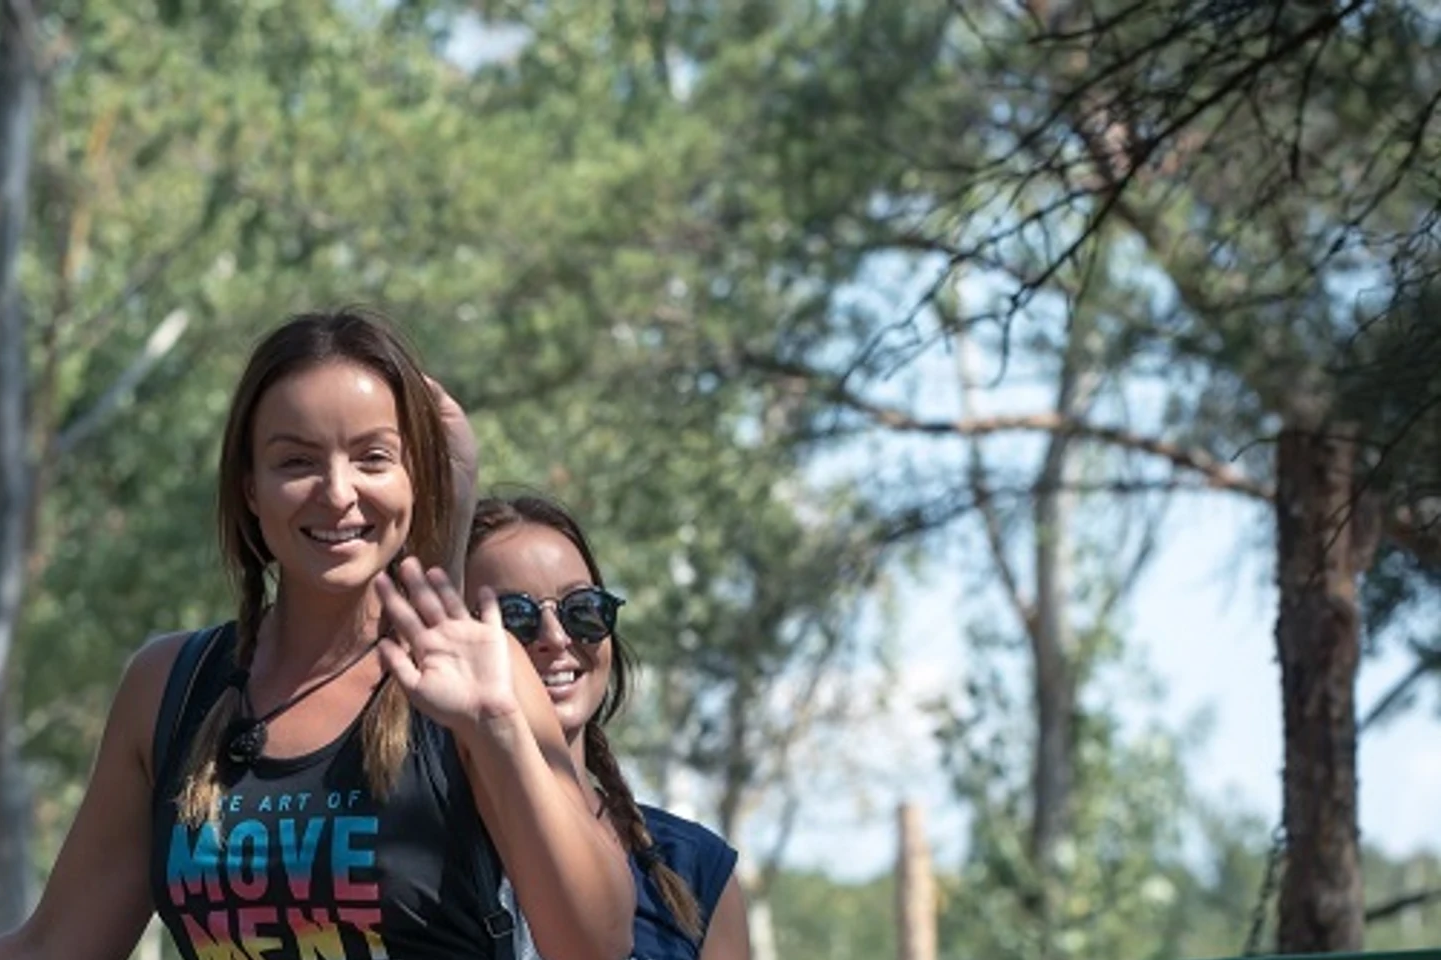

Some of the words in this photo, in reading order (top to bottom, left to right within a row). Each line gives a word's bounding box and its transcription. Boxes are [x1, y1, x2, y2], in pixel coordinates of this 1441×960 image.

[258, 792, 312, 812] ART
[327, 789, 362, 809] OF
[166, 816, 380, 906] MOVE
